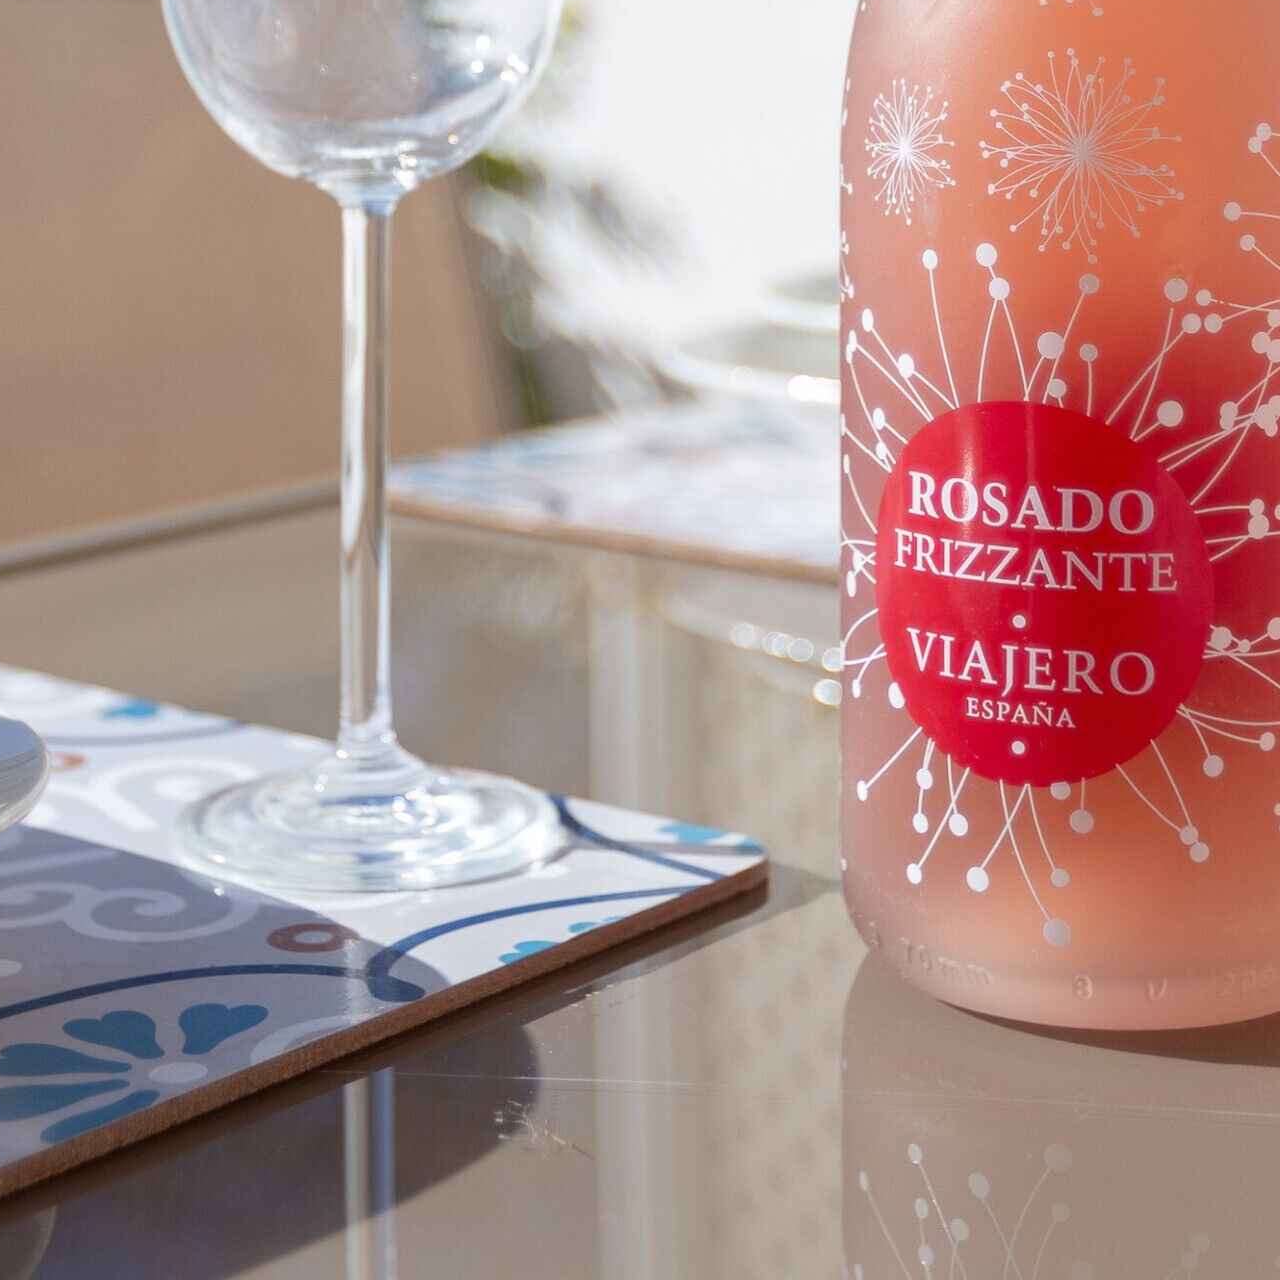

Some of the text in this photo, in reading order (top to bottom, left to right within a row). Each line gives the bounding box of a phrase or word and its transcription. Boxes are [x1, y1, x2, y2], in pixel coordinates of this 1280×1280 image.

[907, 470, 1156, 535] ROSADO
[893, 528, 1178, 593] FRIZZANTE
[905, 627, 1156, 697] VIAJERO
[965, 696, 1076, 729] ESPAÑA
